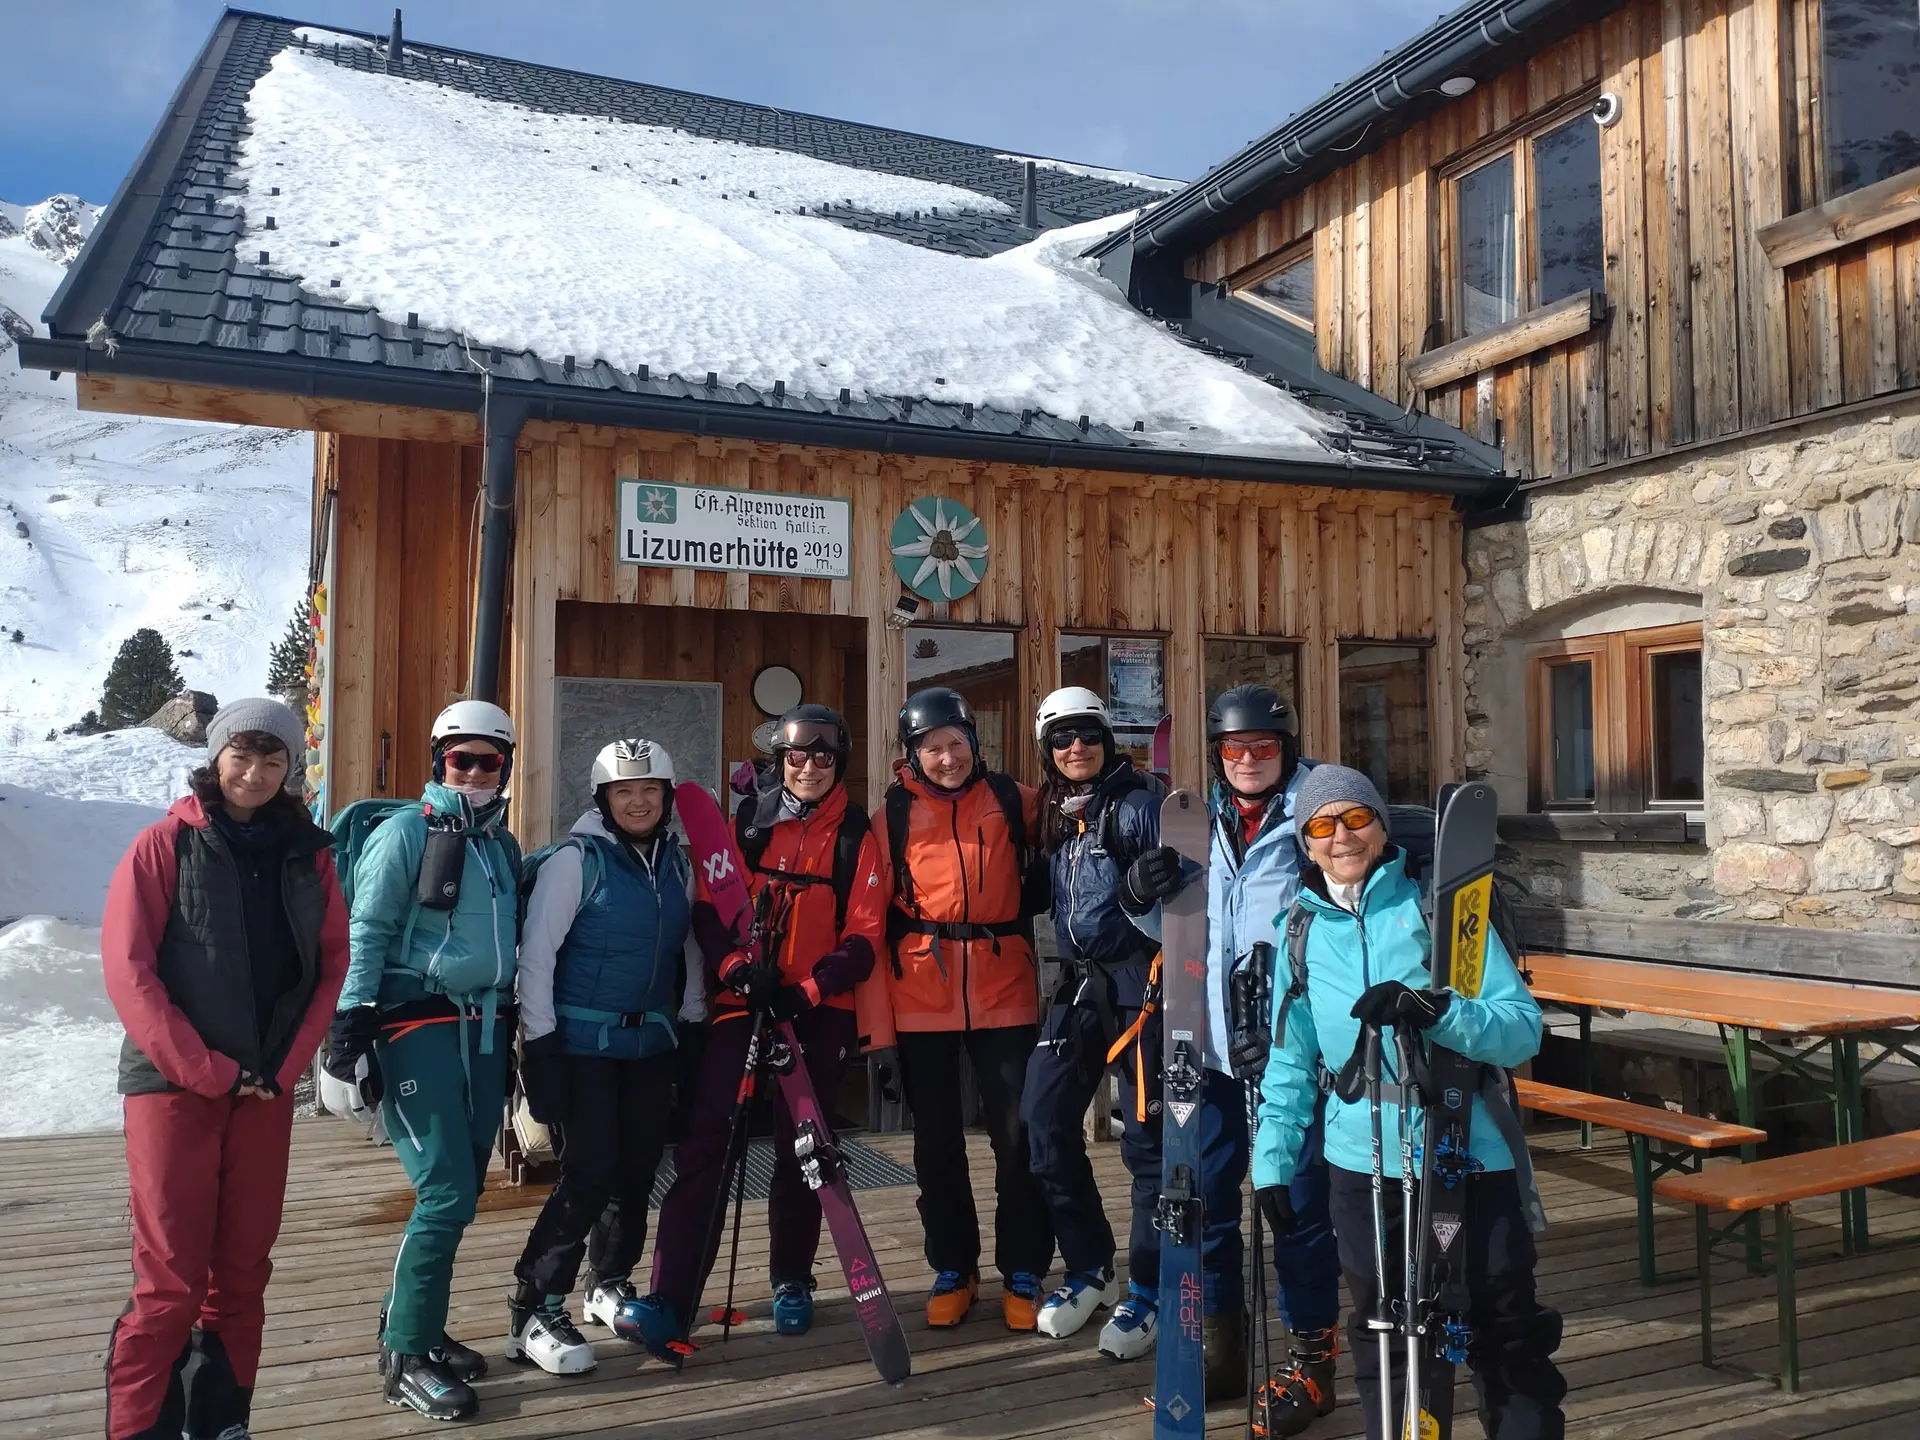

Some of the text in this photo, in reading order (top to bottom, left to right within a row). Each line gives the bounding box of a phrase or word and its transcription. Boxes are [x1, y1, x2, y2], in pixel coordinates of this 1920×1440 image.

[725, 494, 826, 519] Alpenverein
[737, 513, 777, 530] Sektion
[785, 520, 810, 534] Hall
[627, 529, 798, 569] Lizumerhütte
[803, 541, 843, 559] 2019
[1113, 651, 1157, 659] Pendelverkehr
[1458, 912, 1479, 944] K2
[745, 1034, 759, 1070] LEKI
[1401, 1138, 1413, 1195] LEKI
[1180, 1271, 1201, 1289] AL
[855, 1287, 882, 1303] Völkl
[1180, 1289, 1201, 1305] PR
[1180, 1306, 1201, 1323] OU
[1180, 1323, 1200, 1342] TE
